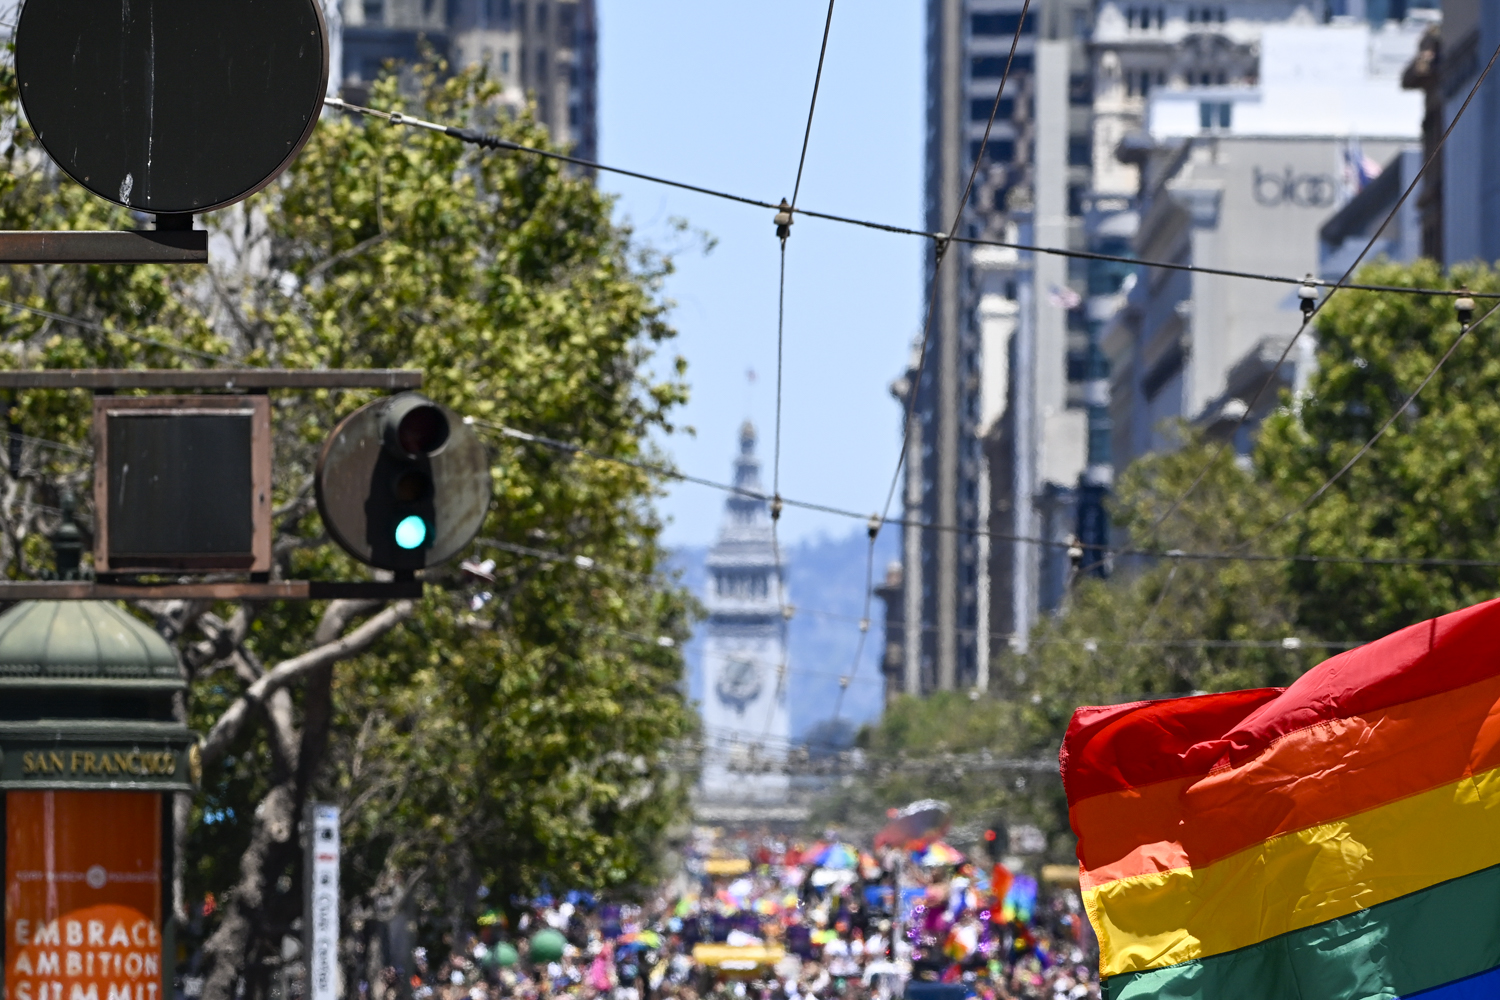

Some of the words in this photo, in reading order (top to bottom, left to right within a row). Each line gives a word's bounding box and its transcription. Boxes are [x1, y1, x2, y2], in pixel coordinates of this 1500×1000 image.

[23, 752, 65, 774] SAN
[71, 752, 175, 776] FRANCISCO
[14, 919, 159, 947] EMBRACE
[13, 951, 159, 978] AMBITION
